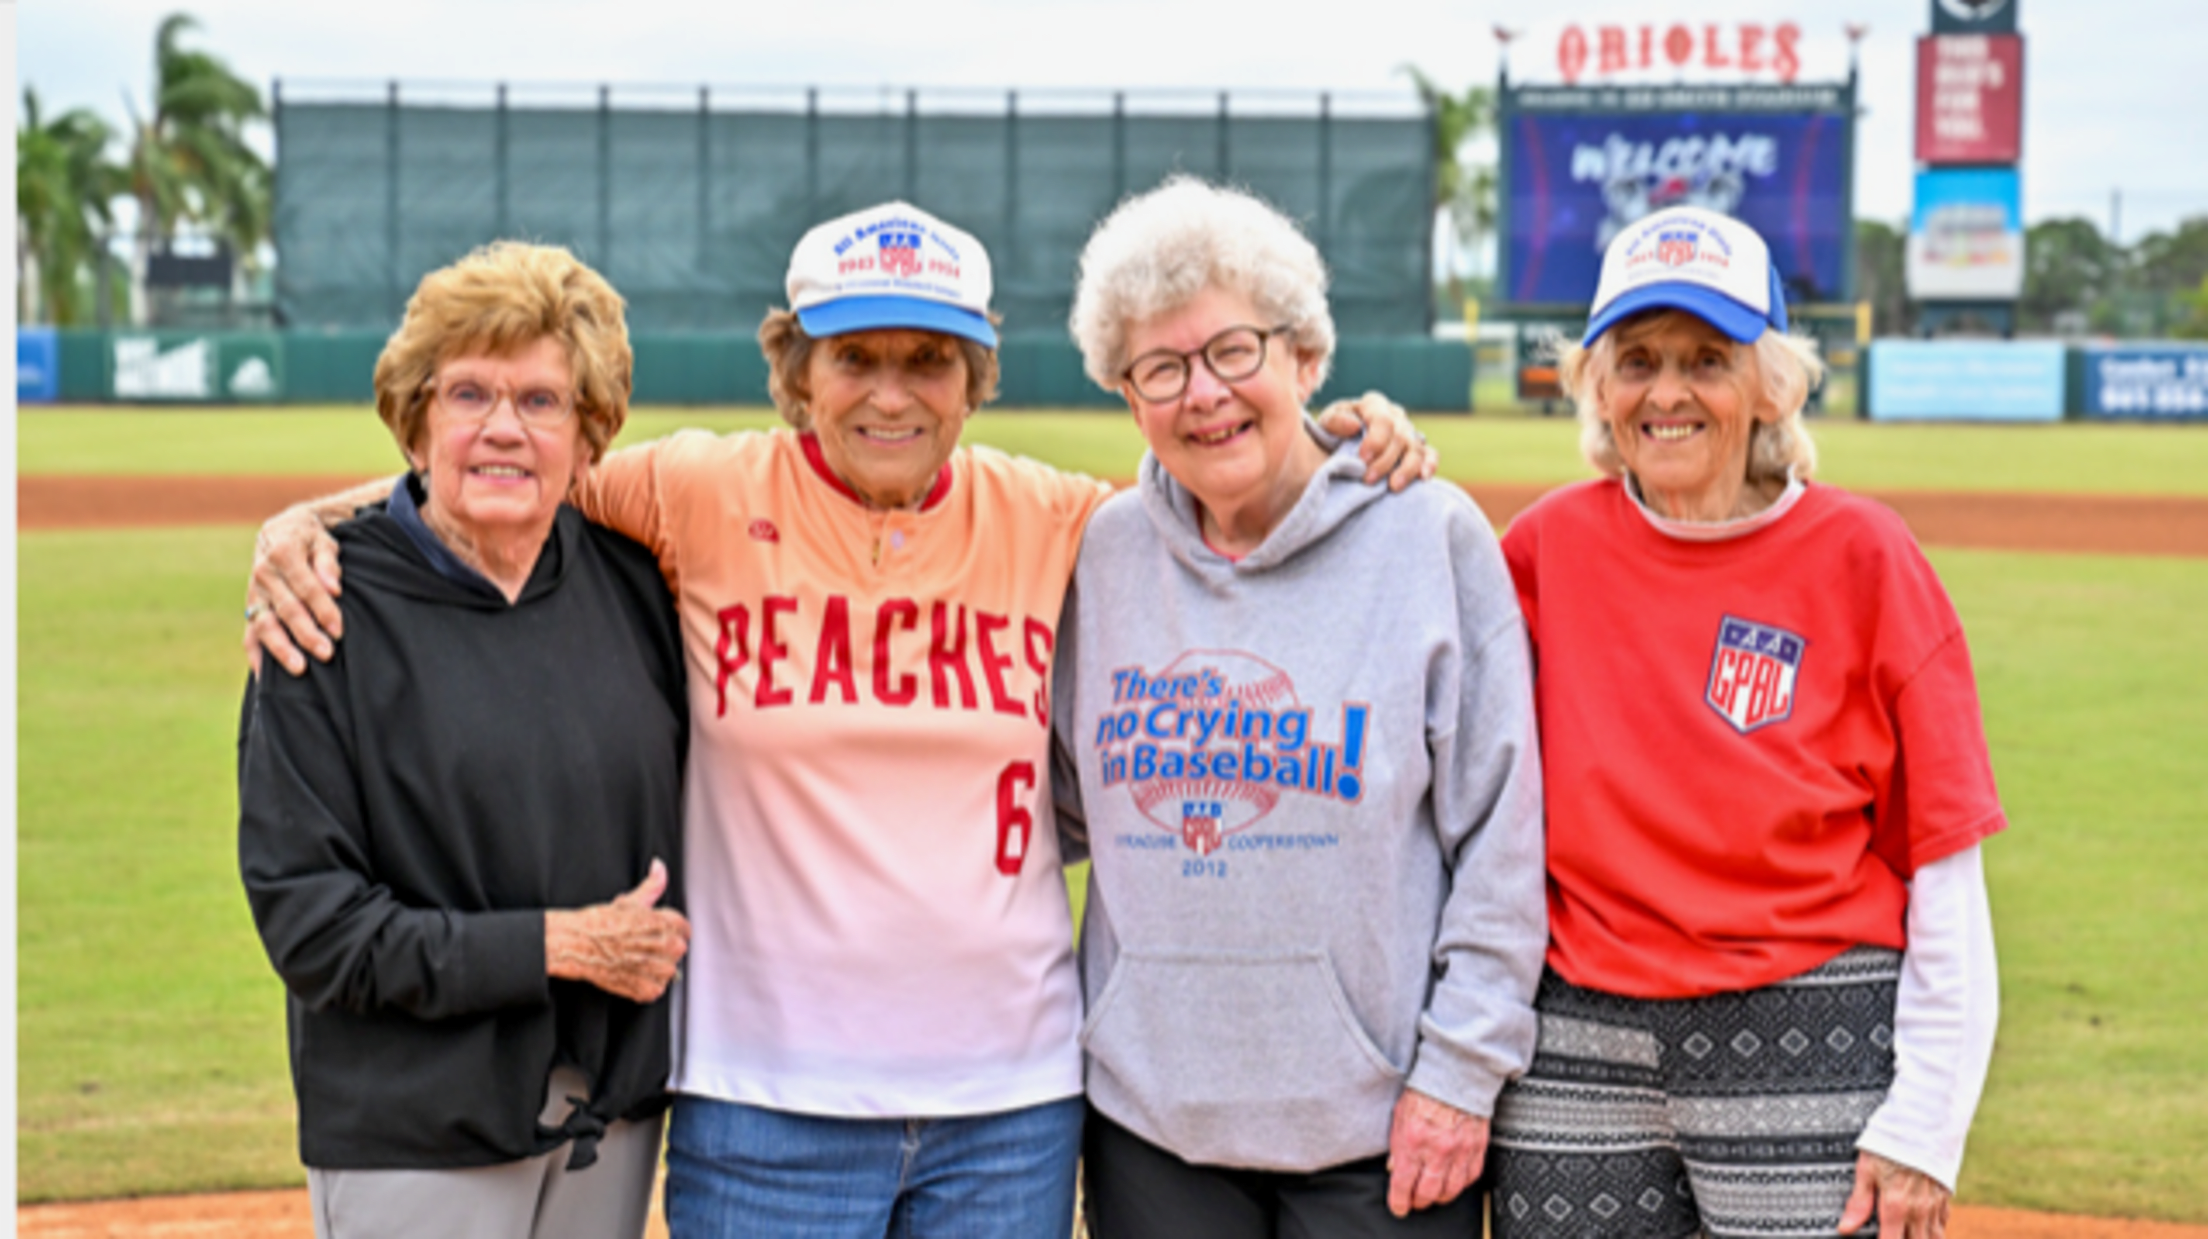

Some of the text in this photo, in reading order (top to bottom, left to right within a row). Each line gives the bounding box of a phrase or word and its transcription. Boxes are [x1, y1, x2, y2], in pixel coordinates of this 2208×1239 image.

[1557, 23, 1801, 84] ORIOLES
[1571, 133, 1778, 182] WELCOME
[715, 594, 1055, 729] PEACHES
[1112, 667, 1225, 702] There's
[1710, 647, 1789, 727] GPBL
[1096, 698, 1312, 752] no Crying
[1102, 703, 1368, 801] in Baseball!
[995, 760, 1036, 877] 6
[1182, 858, 1229, 879] 2012
